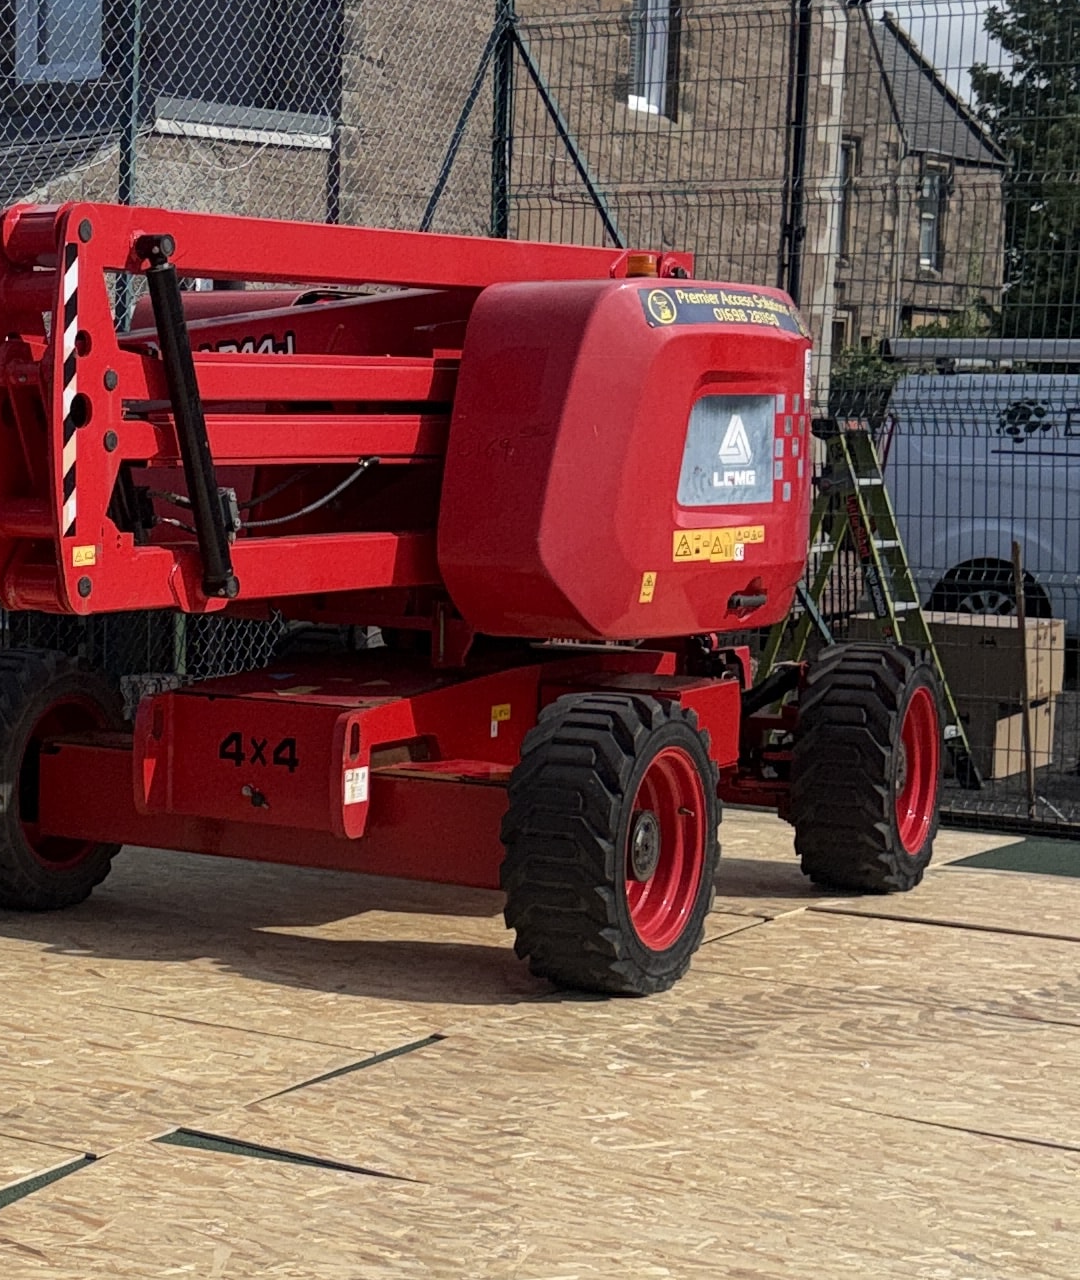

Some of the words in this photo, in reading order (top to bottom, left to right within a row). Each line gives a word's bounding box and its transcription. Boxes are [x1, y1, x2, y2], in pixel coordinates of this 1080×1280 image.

[675, 289, 719, 305] Premier
[720, 291, 755, 307] Access
[713, 470, 756, 487] LCMG
